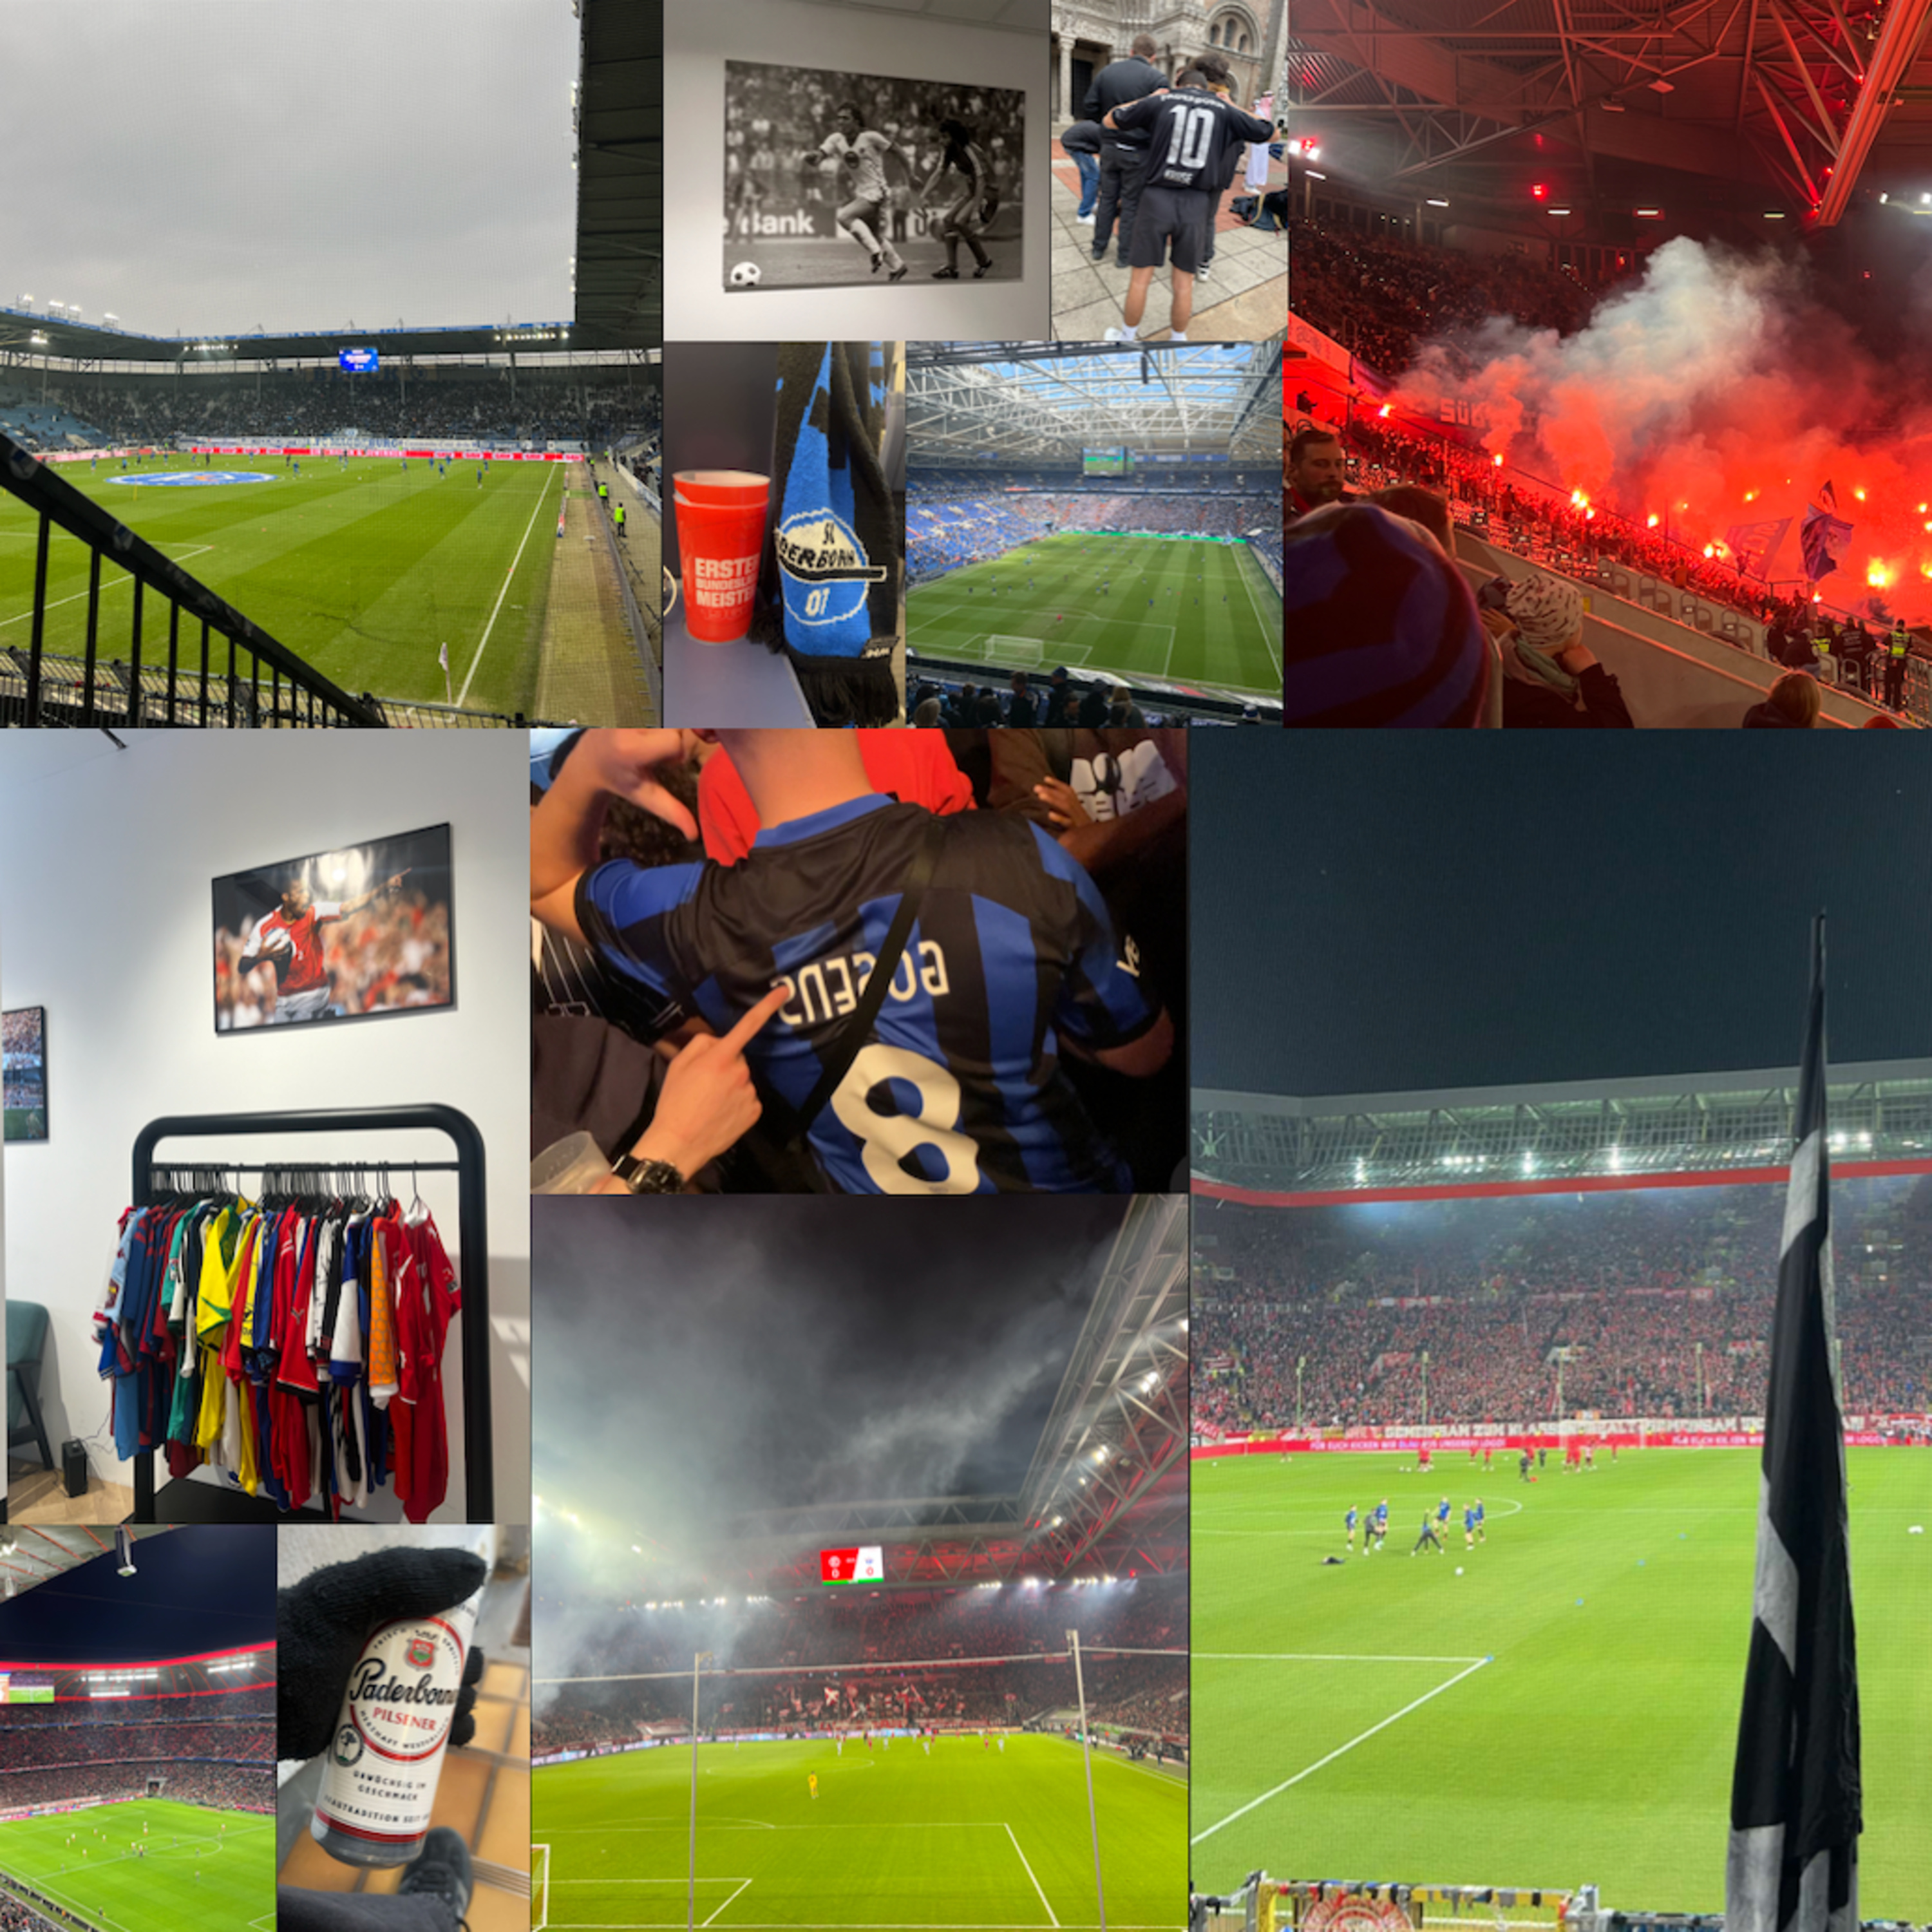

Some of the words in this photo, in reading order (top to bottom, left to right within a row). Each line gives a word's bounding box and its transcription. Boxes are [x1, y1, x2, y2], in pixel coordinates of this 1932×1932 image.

[1167, 104, 1215, 169] 10
[696, 585, 756, 607] MEISTE
[372, 1707, 437, 1732] PILSENER
[357, 1783, 418, 1801] GESCHMACK
